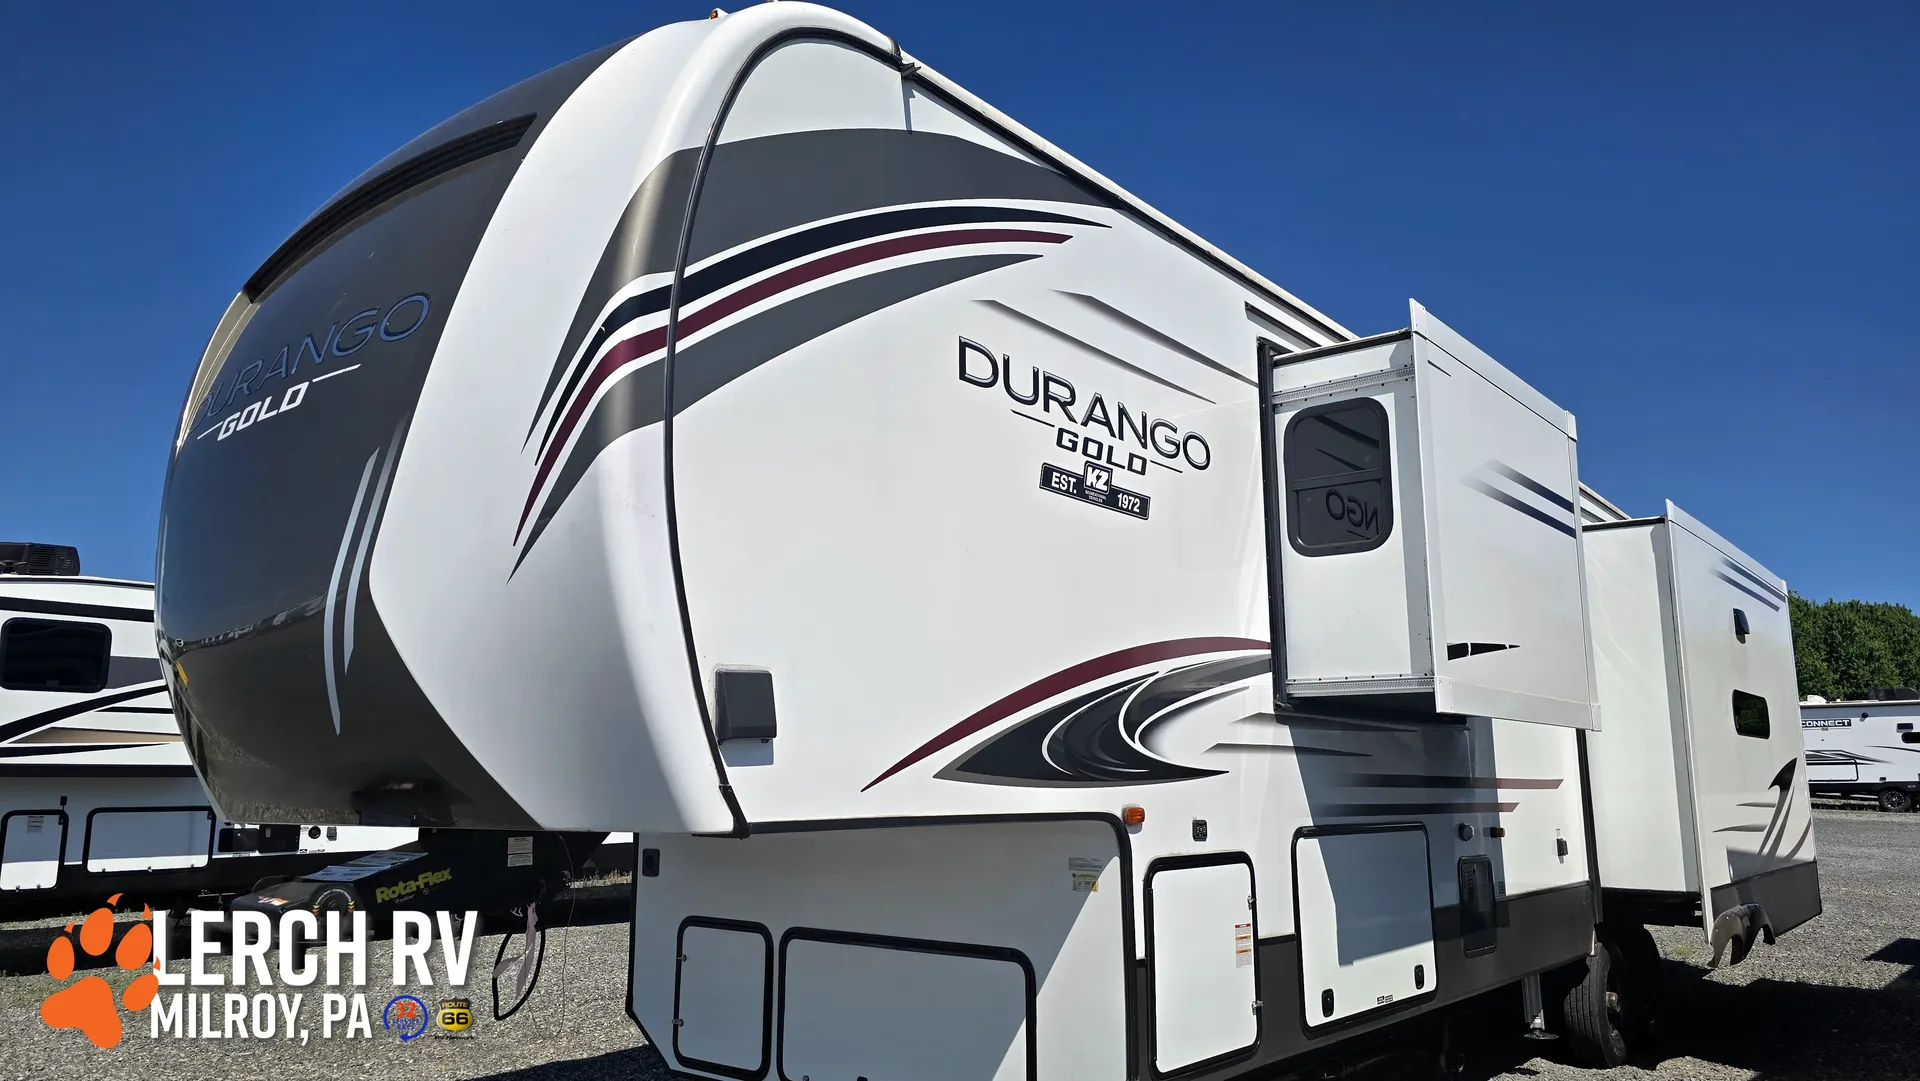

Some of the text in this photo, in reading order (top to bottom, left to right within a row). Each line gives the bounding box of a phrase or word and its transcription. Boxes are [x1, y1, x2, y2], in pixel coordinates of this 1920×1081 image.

[217, 381, 310, 442] GOLD
[958, 335, 1211, 471] DURANGO
[1056, 427, 1147, 476] GOLD
[1051, 471, 1140, 512] EST. 1972
[1086, 466, 1109, 491] KZ
[1802, 719, 1850, 728] CONNECT
[375, 868, 453, 903] Rota-Flex
